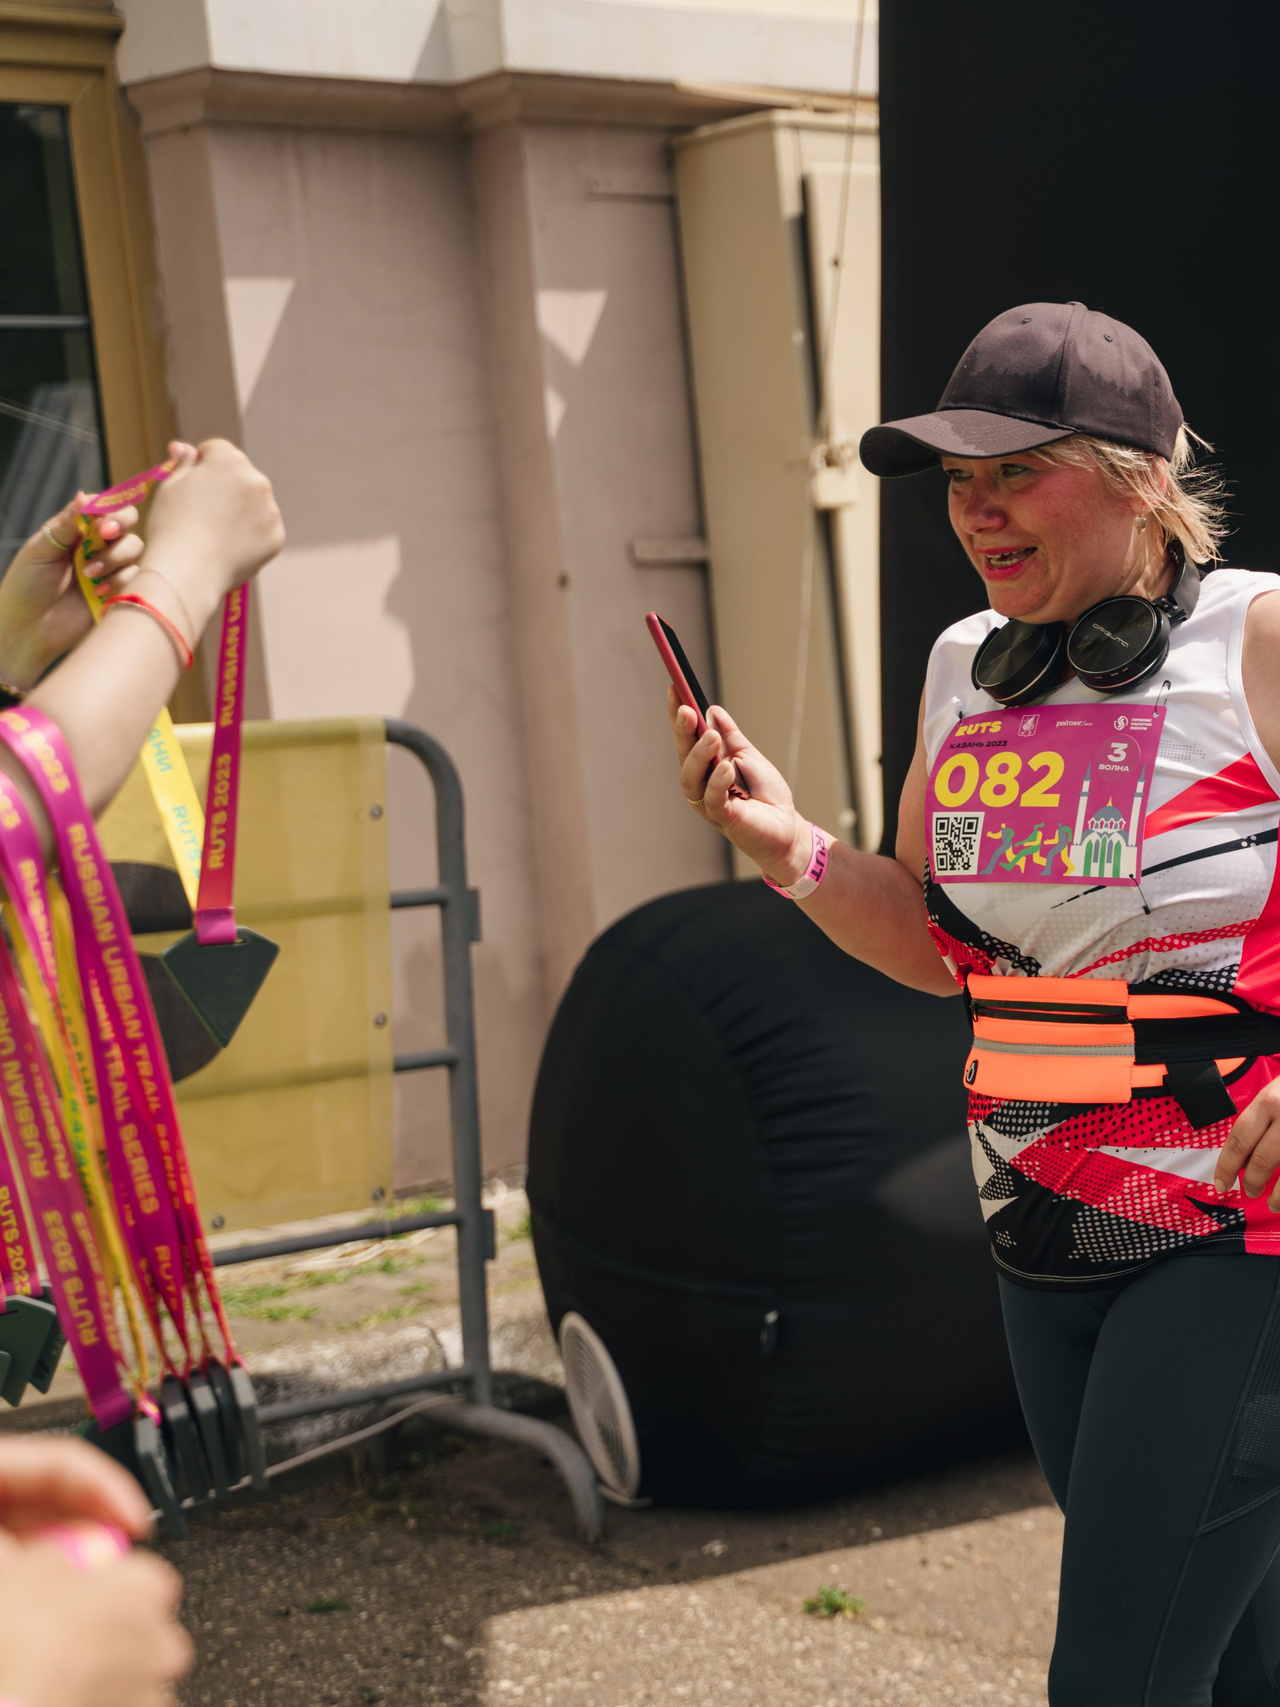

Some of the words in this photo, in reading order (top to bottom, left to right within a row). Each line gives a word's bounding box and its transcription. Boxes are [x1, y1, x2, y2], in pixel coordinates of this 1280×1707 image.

[220, 623, 241, 727] RUSSIAN
[949, 741, 984, 750] КАЗАНЬ
[986, 740, 1008, 748] 2023
[955, 721, 1002, 737] RUTS
[1107, 742, 1128, 762] 3
[213, 752, 233, 809] 2023
[934, 751, 1065, 808] 082
[1098, 763, 1130, 772] ВОЛНА
[173, 804, 203, 863] RUTS
[207, 811, 228, 870] RUTS
[67, 823, 117, 943] RUSSIAN
[101, 945, 144, 1040] URBAN
[133, 1042, 162, 1116] TRAIL
[3, 1060, 50, 1179] RUSSIAN
[104, 1042, 132, 1122] TRAIL
[119, 1122, 160, 1215] SERIES
[0, 1185, 20, 1243] RUTS
[42, 1210, 78, 1273] 2023
[7, 1244, 32, 1297] 2023
[62, 1276, 100, 1347] RUTS
